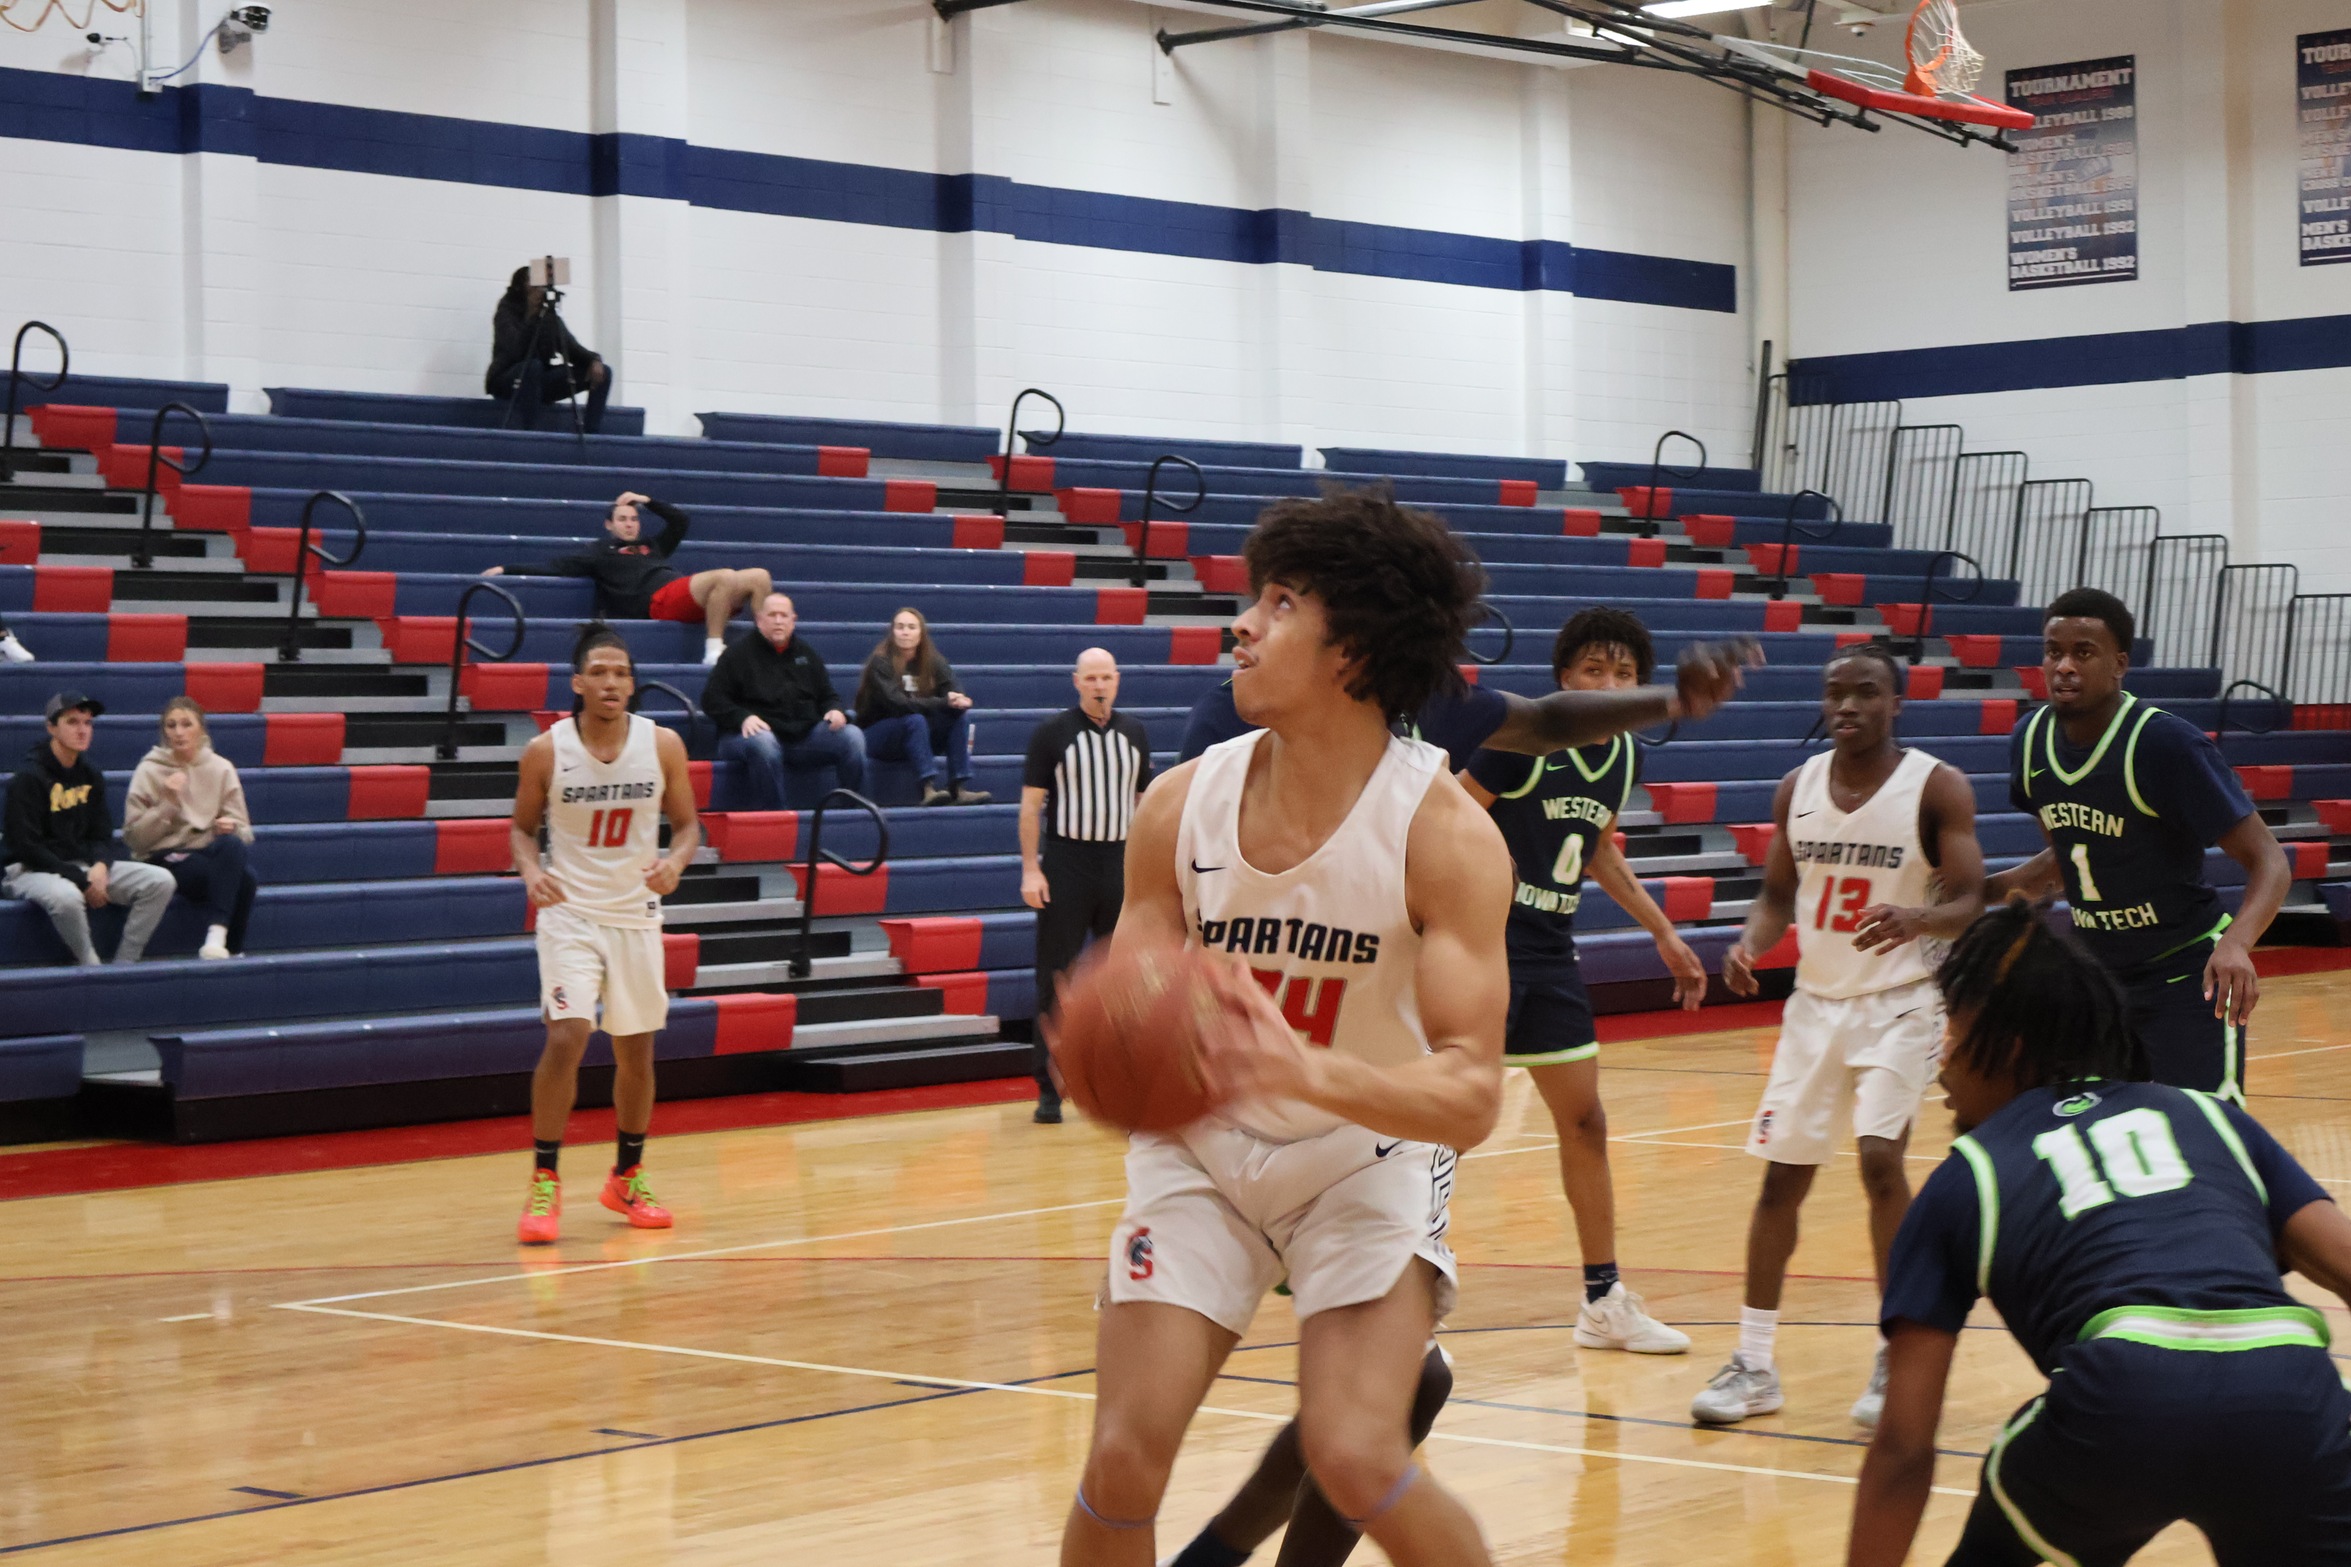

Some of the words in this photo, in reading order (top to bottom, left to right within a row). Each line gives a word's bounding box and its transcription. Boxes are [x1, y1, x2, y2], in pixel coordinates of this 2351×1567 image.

[2009, 68, 2132, 97] TOURNAMENT
[2030, 109, 2101, 130] LEYBALL
[2012, 202, 2101, 222] VOLLEYBALL
[2010, 224, 2101, 243] VOLLEYBALL
[2010, 247, 2078, 265] WOMEN'S
[2010, 259, 2101, 279] BASKETBALL
[2102, 255, 2135, 270] 1992
[562, 781, 655, 803] SPARTANS
[587, 807, 634, 848] 10
[1552, 833, 1584, 885] 0
[1794, 841, 1903, 869] SPARTANS
[2070, 843, 2103, 901] 1
[1814, 875, 1872, 933] 13
[2095, 902, 2159, 931] TECH
[1250, 966, 1349, 1049] 4
[2031, 1108, 2196, 1222] 10
